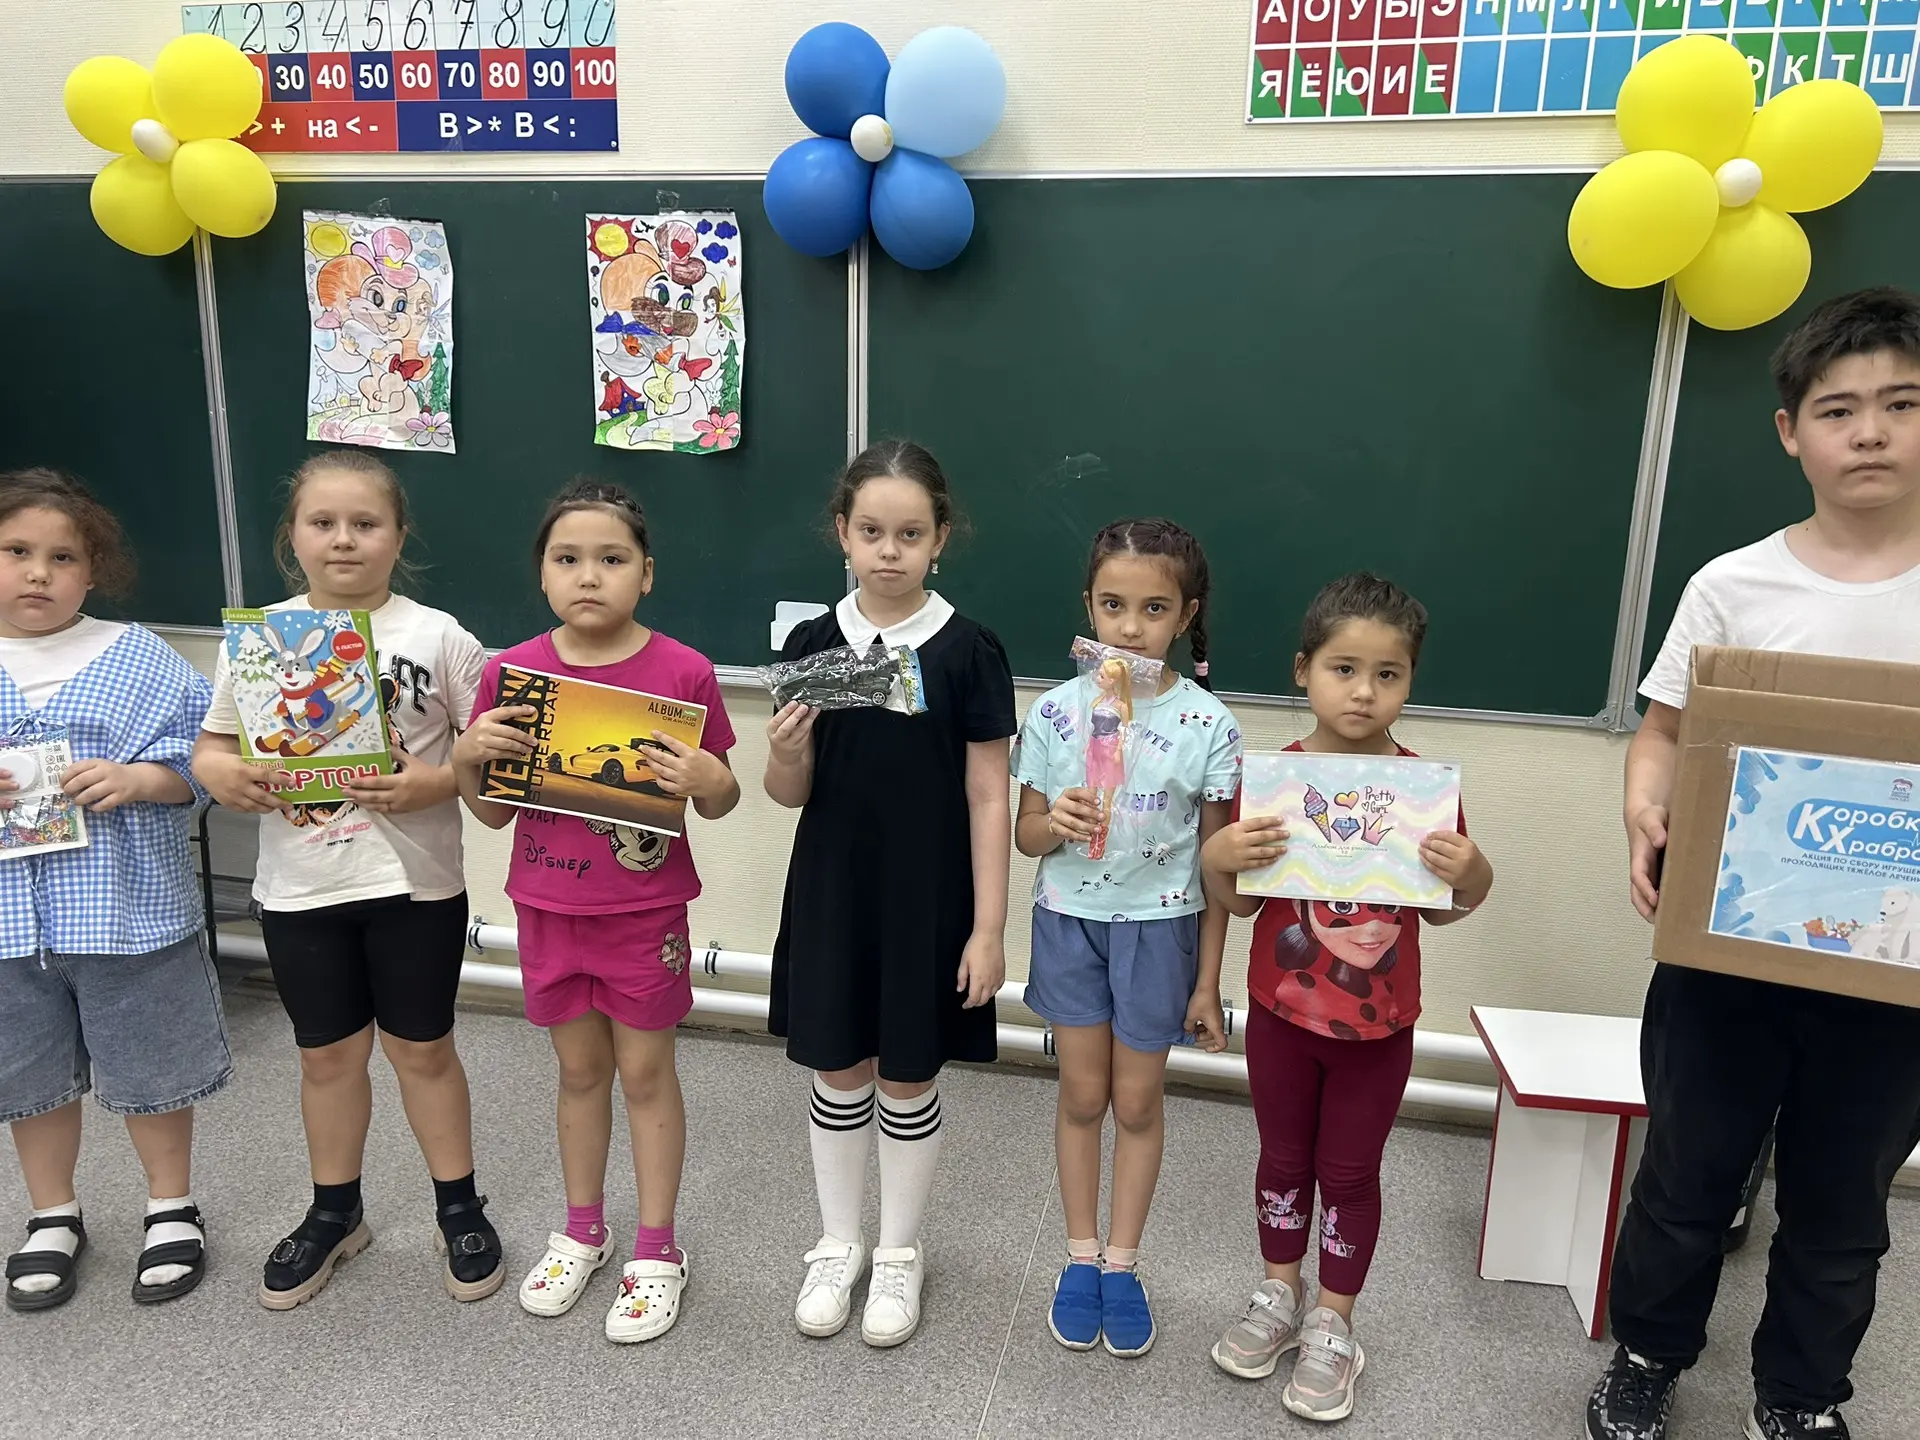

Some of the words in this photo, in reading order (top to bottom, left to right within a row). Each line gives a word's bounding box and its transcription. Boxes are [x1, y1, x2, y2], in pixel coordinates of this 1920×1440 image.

[1262, 0, 1288, 23] А
[1304, 0, 1330, 21] О
[241, 3, 266, 52] 2
[279, 1, 304, 52] 3
[323, 0, 347, 52] 4
[362, 0, 389, 51] 5
[403, 0, 433, 50] 6
[455, 0, 476, 49] 7
[495, 0, 523, 48] 8
[539, 0, 569, 48] 9
[275, 65, 304, 91] 30
[316, 64, 346, 90] 40
[359, 63, 389, 89] 50
[401, 62, 432, 89] 60
[444, 61, 476, 88] 70
[488, 61, 520, 88] 80
[532, 60, 565, 87] 90
[574, 59, 615, 86] 100
[1258, 69, 1283, 98] Я
[1300, 63, 1323, 98] Ё
[1335, 67, 1370, 96] Ю
[1382, 65, 1407, 95] И
[1424, 64, 1447, 93] Е
[1782, 54, 1809, 84] К
[1830, 54, 1855, 80] Т
[1869, 52, 1911, 84] Ш
[308, 119, 338, 138] на
[439, 112, 459, 138] В
[515, 112, 535, 138] В
[648, 702, 682, 718] ALBUM
[662, 716, 696, 727] DRAWING
[1041, 700, 1075, 742] GIRL
[485, 668, 545, 797] YEOW
[530, 681, 560, 802] SUPERCAR
[254, 764, 379, 793] РТОН
[1365, 786, 1395, 806] Pretty
[1781, 857, 1844, 872] ПРОХОДЯЩИХ
[1847, 867, 1887, 878] ТЯЖЁЛОЕ
[1801, 853, 1831, 863] АКЦИЯ
[1833, 856, 1847, 865] ПО
[1850, 857, 1880, 869] СБОРУ
